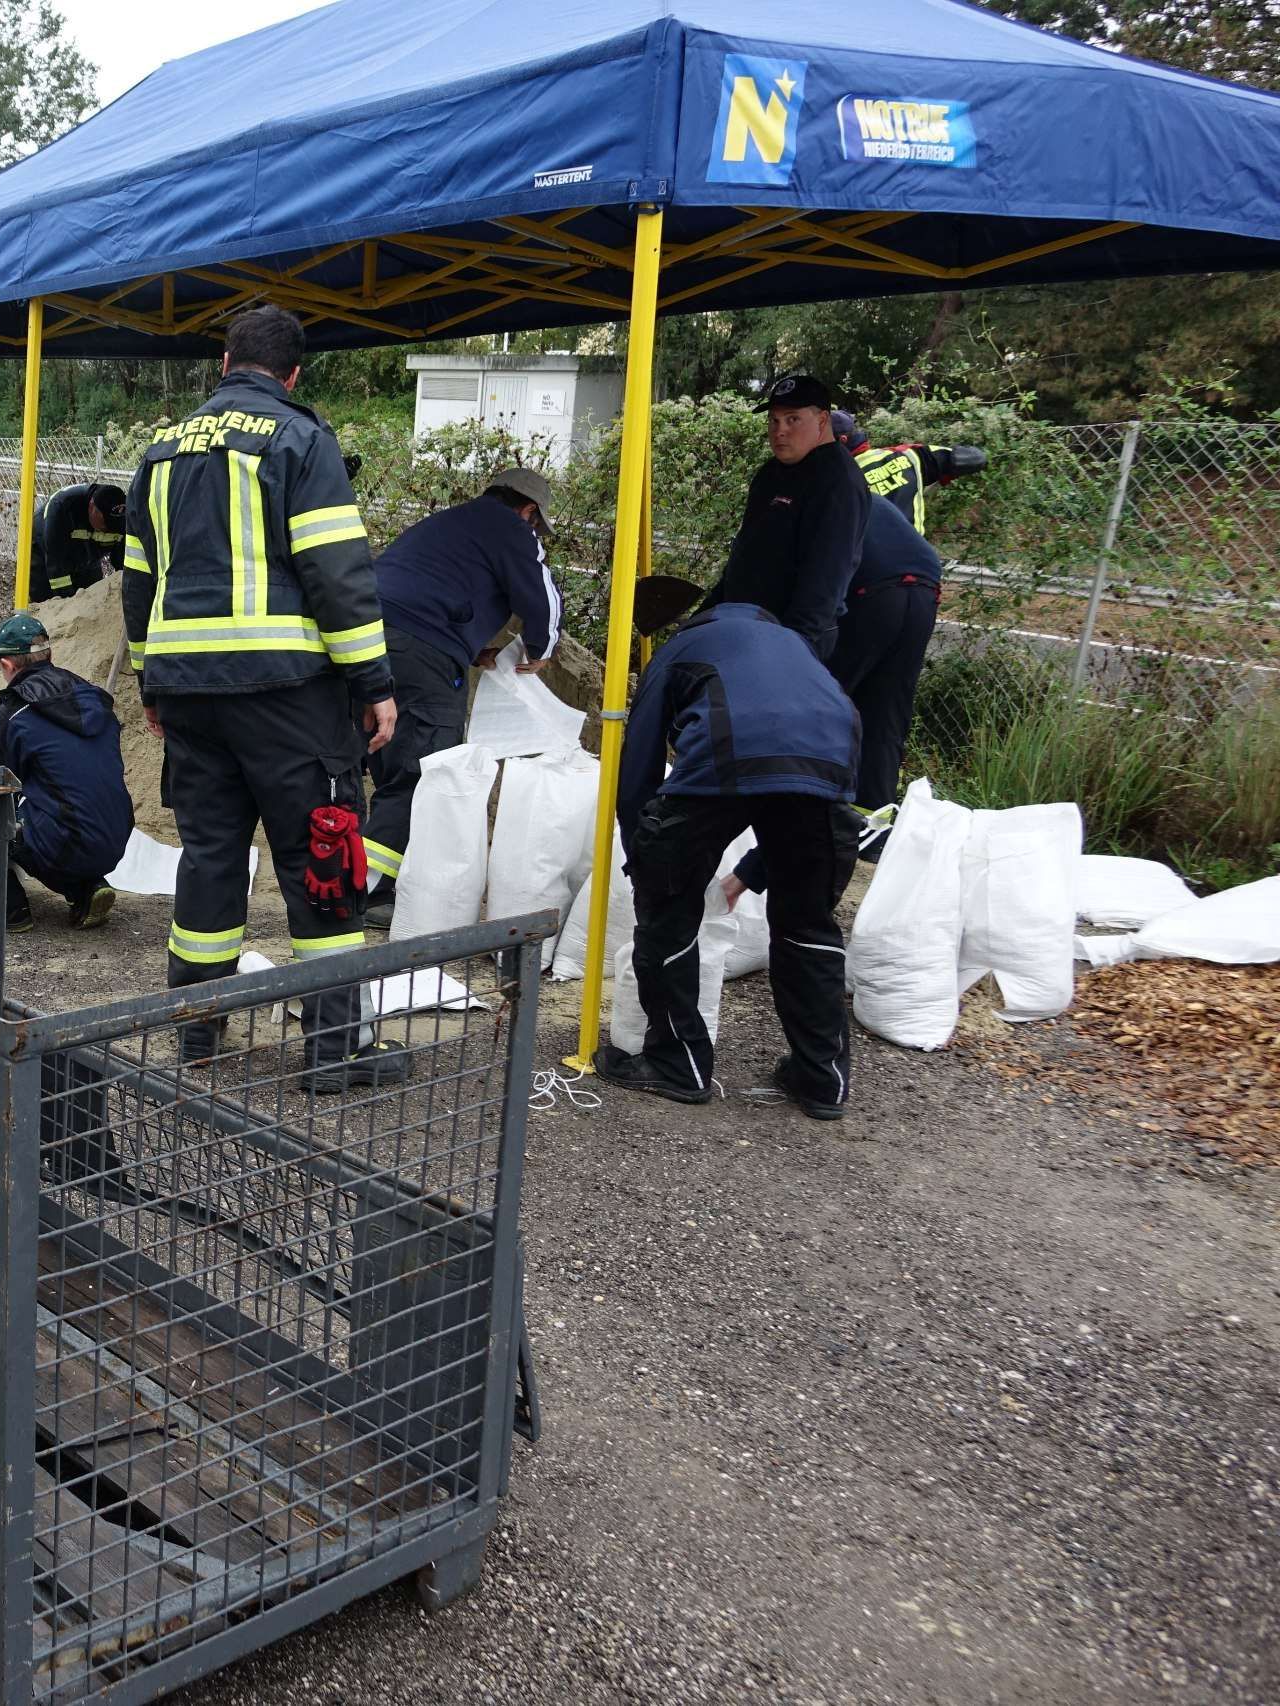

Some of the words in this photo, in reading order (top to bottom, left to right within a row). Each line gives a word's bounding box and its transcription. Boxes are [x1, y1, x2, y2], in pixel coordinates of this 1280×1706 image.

[723, 76, 789, 164] N
[853, 98, 950, 145] NOTRUF
[534, 169, 593, 189] MASTERTENT
[175, 428, 231, 454] MEK
